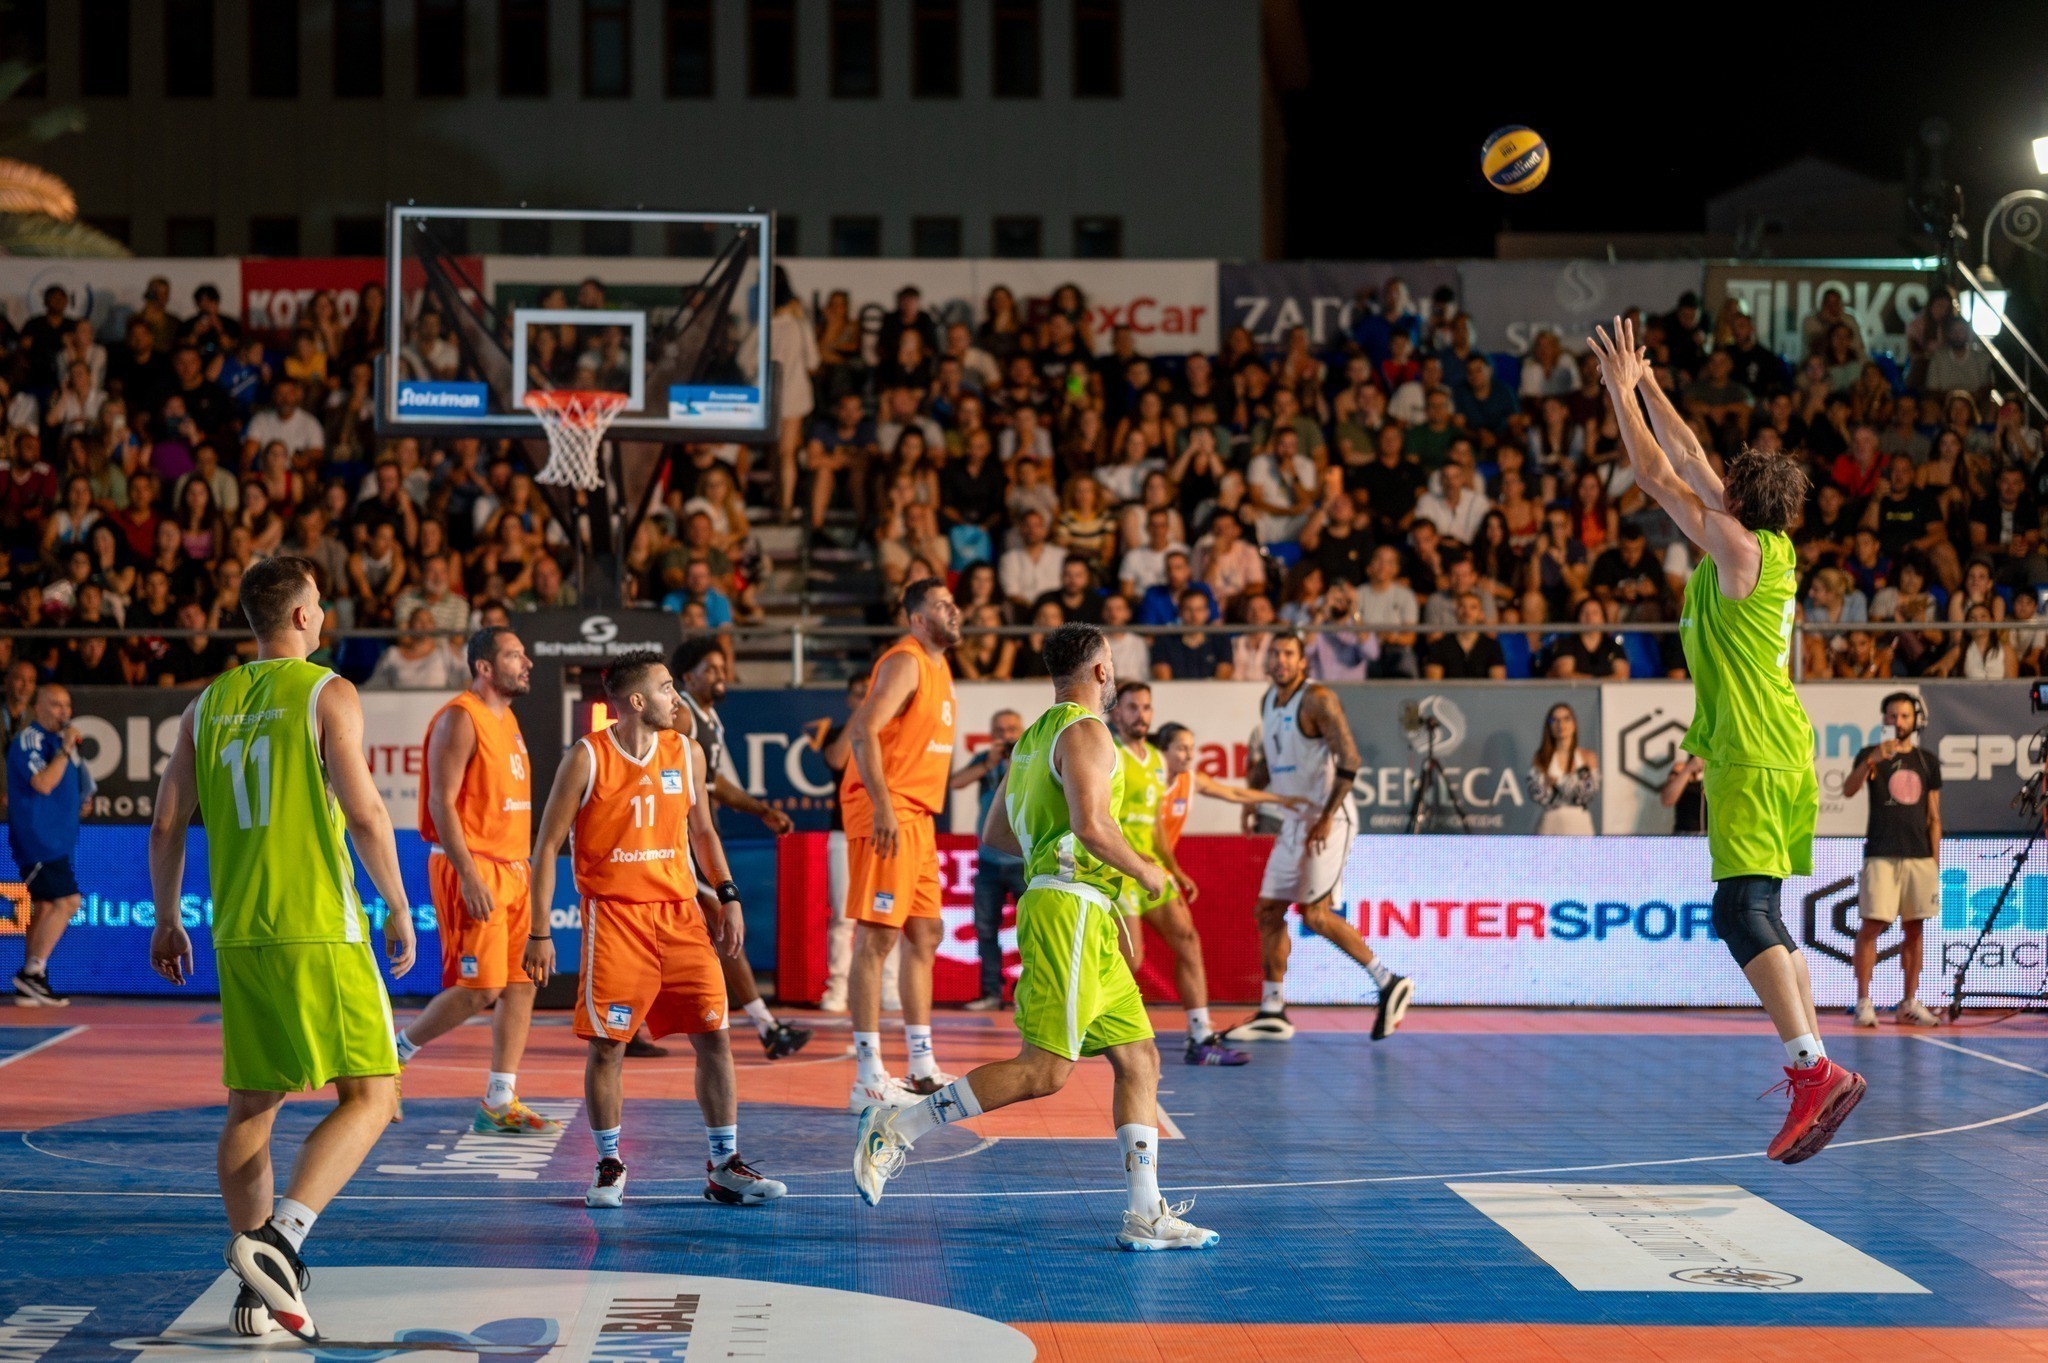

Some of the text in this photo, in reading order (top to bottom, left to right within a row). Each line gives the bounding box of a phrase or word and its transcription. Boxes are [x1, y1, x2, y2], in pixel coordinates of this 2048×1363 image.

[219, 735, 270, 830] 11
[94, 795, 153, 818] ROS
[630, 794, 656, 829] 11
[609, 847, 676, 864] Stoiximan
[1356, 899, 1720, 942] INTERSPOR
[1138, 1155, 1150, 1165] 15
[587, 1293, 701, 1363] ANBALL
